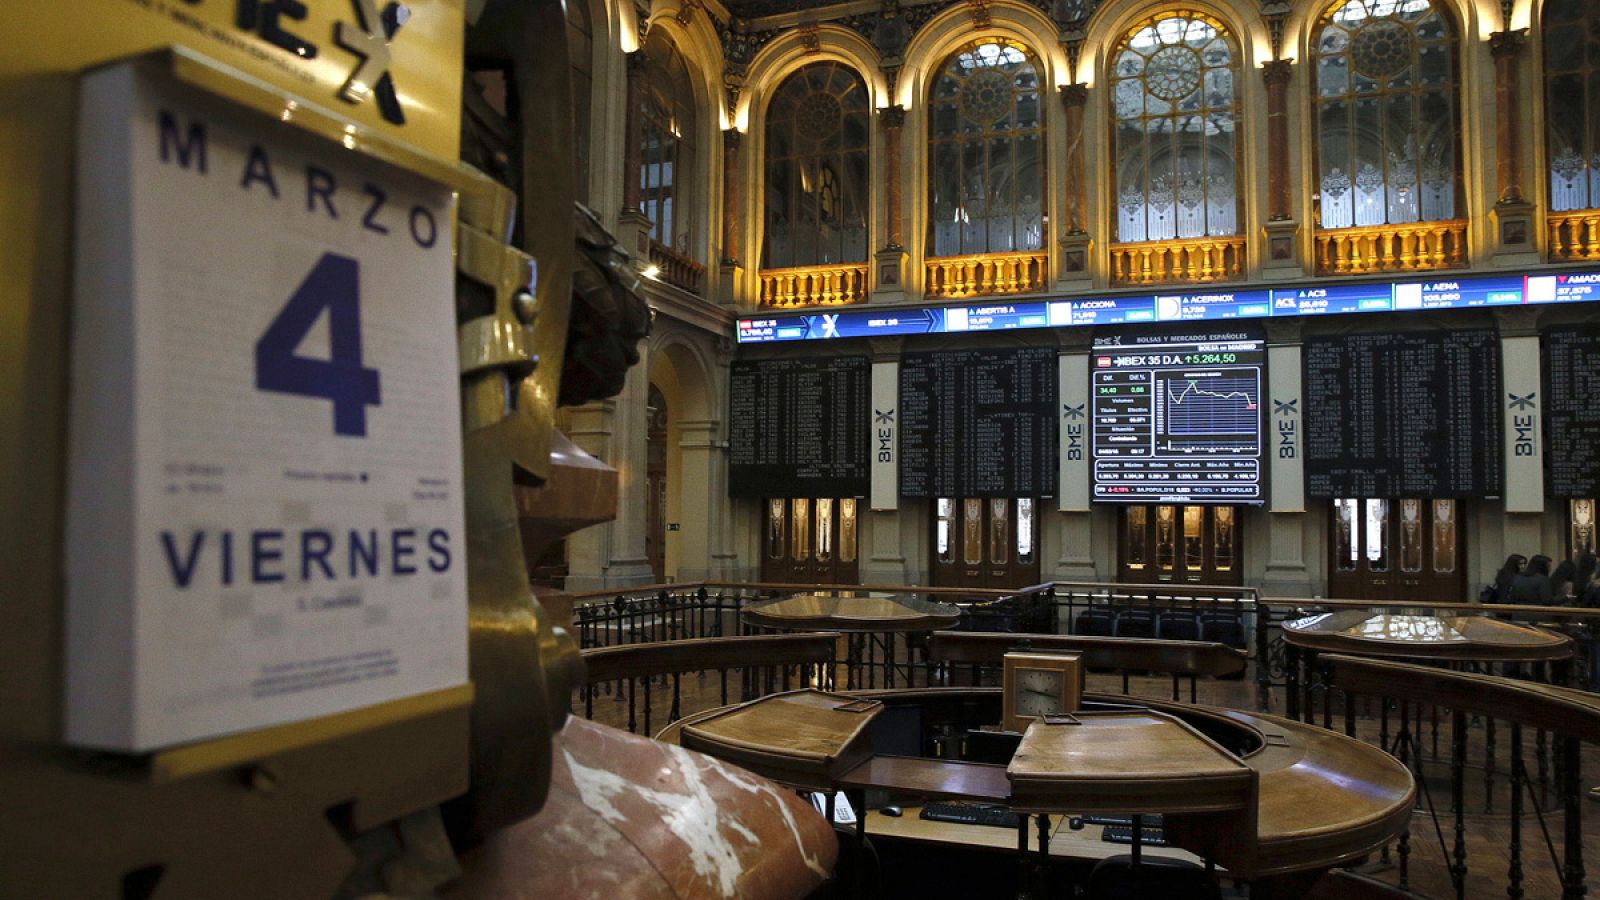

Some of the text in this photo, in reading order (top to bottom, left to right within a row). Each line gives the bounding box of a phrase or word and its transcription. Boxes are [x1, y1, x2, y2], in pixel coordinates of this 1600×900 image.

[157, 110, 438, 249] MARZO
[1080, 300, 1116, 309] ACCIONA
[255, 251, 382, 437] 4
[1148, 356, 1161, 365] 35
[1162, 354, 1183, 364] D.A.
[1193, 354, 1236, 363] 5.264,50
[878, 428, 892, 462] BME
[1068, 424, 1082, 460] BME
[1280, 420, 1296, 459] BME
[1514, 415, 1533, 456] BME
[160, 527, 452, 589] VIERNES
